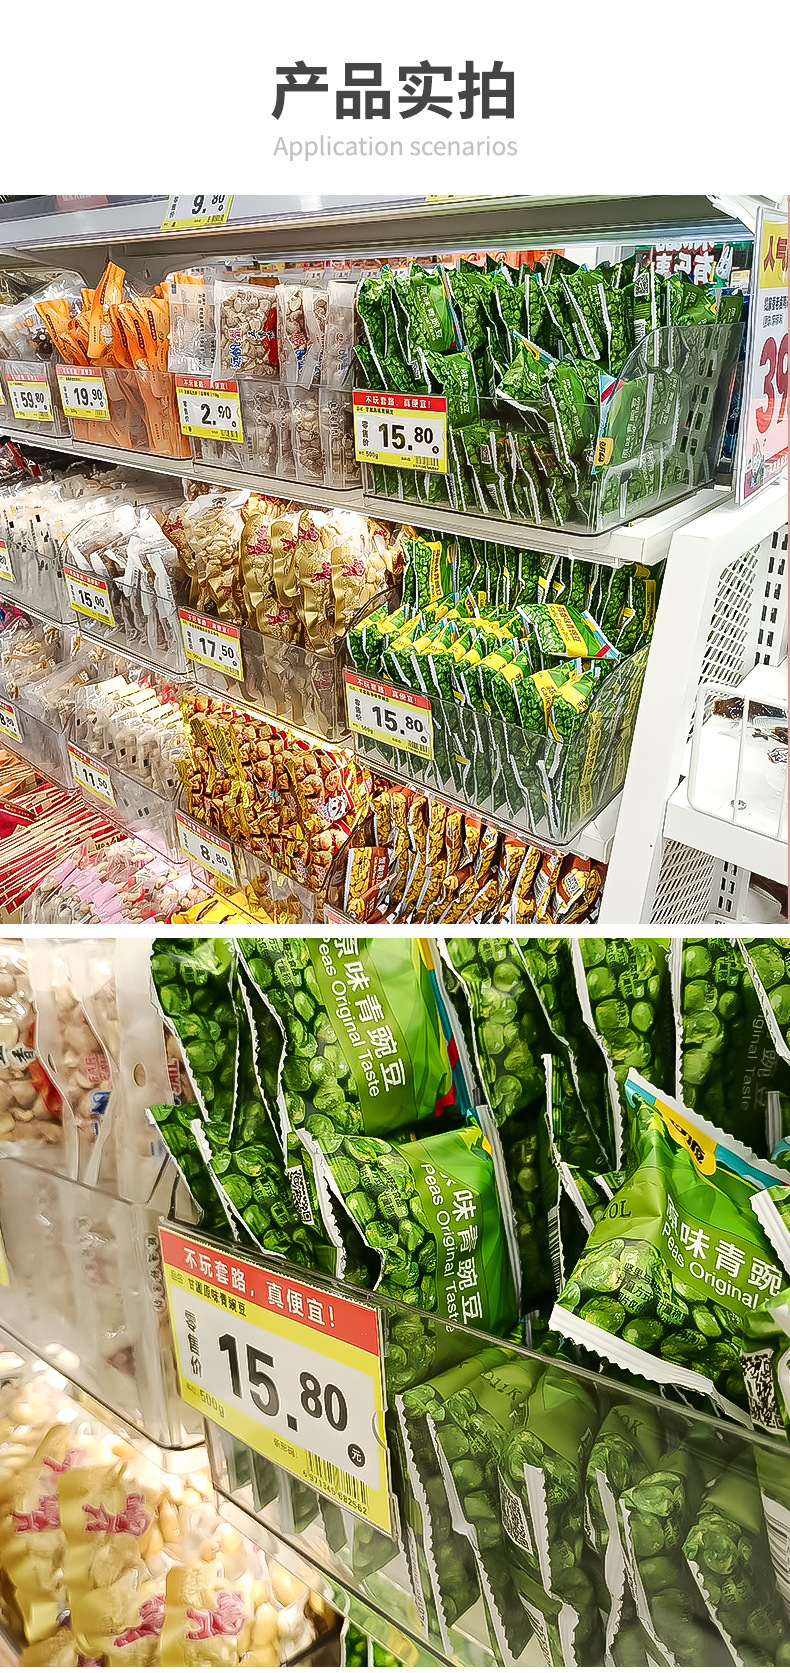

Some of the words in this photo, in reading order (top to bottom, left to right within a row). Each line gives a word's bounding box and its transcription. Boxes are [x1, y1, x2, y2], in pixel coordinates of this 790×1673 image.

[73, 387, 102, 406] 19.90
[200, 403, 232, 426] 2.90
[378, 423, 434, 451] 15.80
[78, 589, 105, 609] 15.00
[199, 637, 235, 661] 17.50
[372, 705, 424, 735] 15.80
[331, 980, 367, 1048] Original
[357, 1048, 381, 1098] Taste
[420, 1163, 444, 1207] Peas
[436, 1209, 459, 1278] Original
[183, 1246, 336, 1328] 不玩套路，真便宜！
[661, 1221, 686, 1269] Peas
[689, 1261, 759, 1311] Original
[444, 1280, 460, 1333] Taste
[183, 1309, 203, 1378] 零售价
[218, 1333, 348, 1433] 15.80
[337, 1491, 368, 1516] 682562
